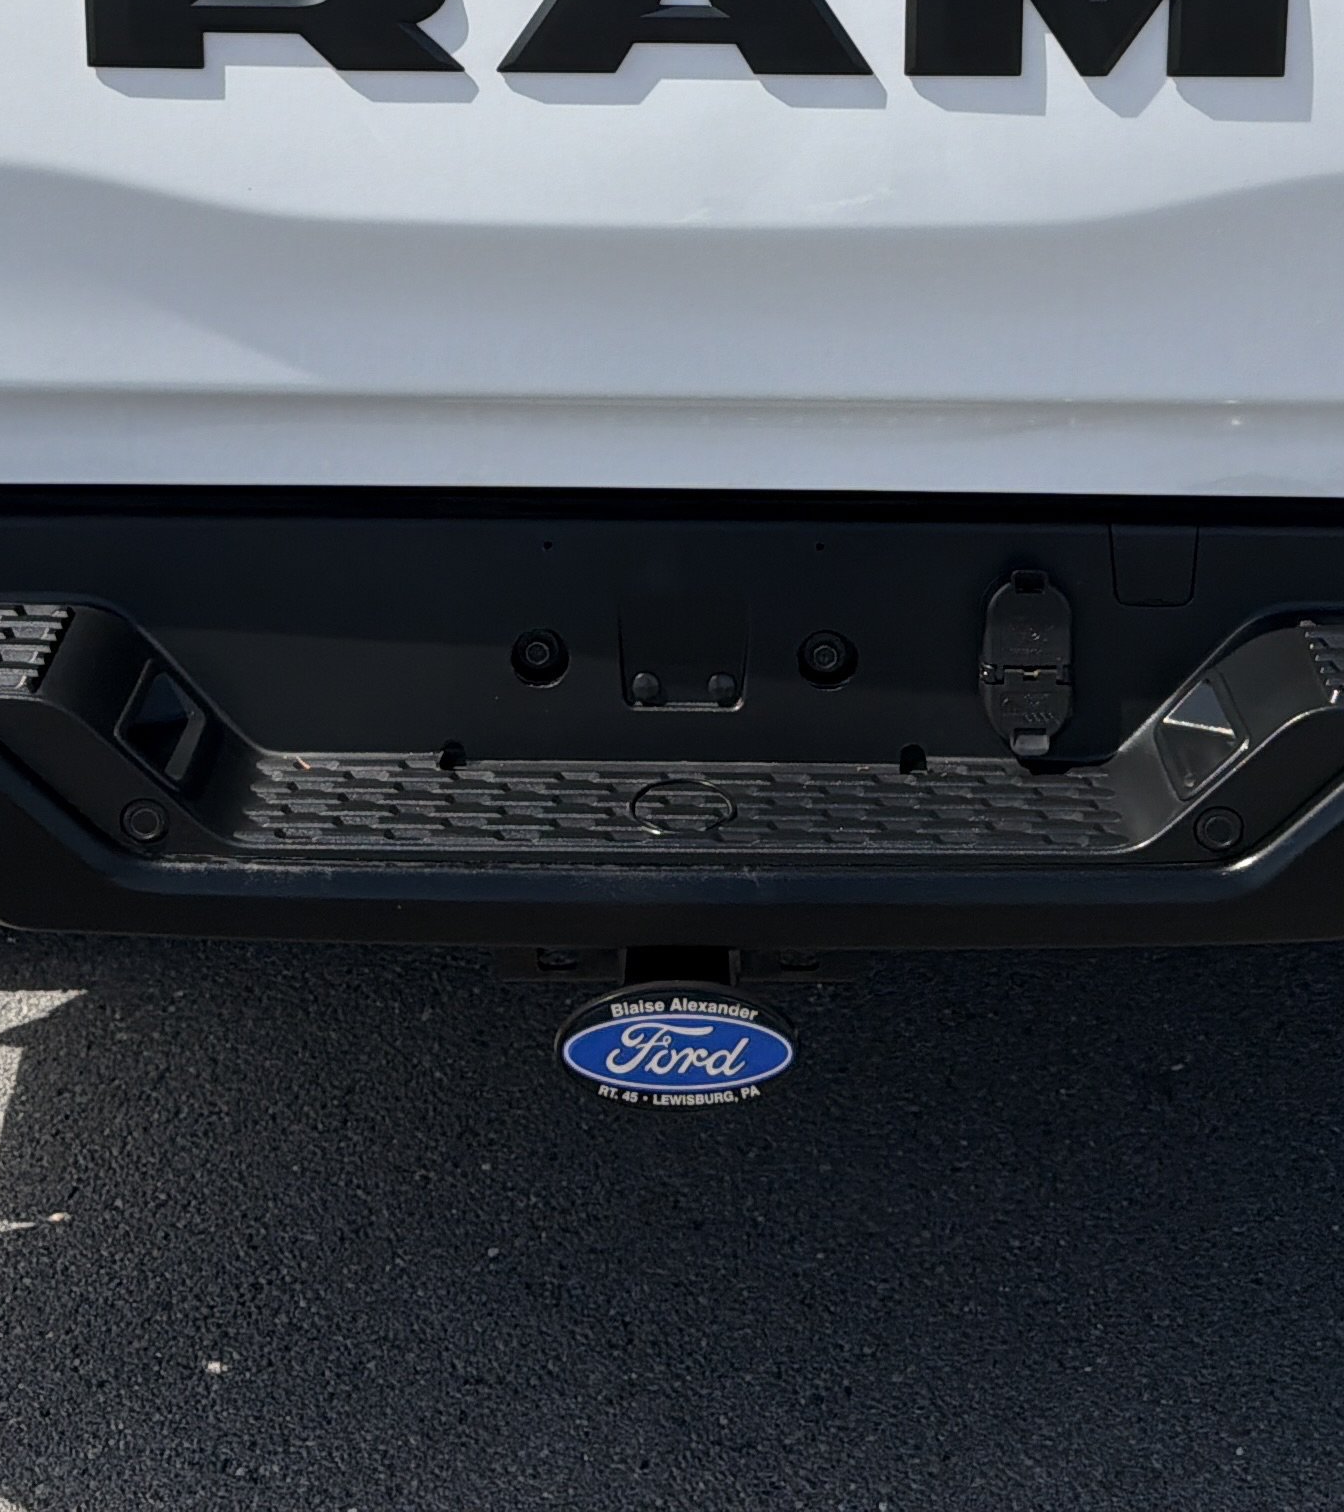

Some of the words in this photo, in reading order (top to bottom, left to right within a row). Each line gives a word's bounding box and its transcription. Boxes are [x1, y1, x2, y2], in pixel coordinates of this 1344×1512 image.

[610, 999, 665, 1018] Blaise
[669, 997, 759, 1021] Alexander
[606, 1022, 750, 1076] Ford
[597, 1084, 619, 1100] RT.
[621, 1090, 639, 1103] 45
[652, 1090, 739, 1106] LEWISBURG,
[740, 1084, 761, 1099] PA
